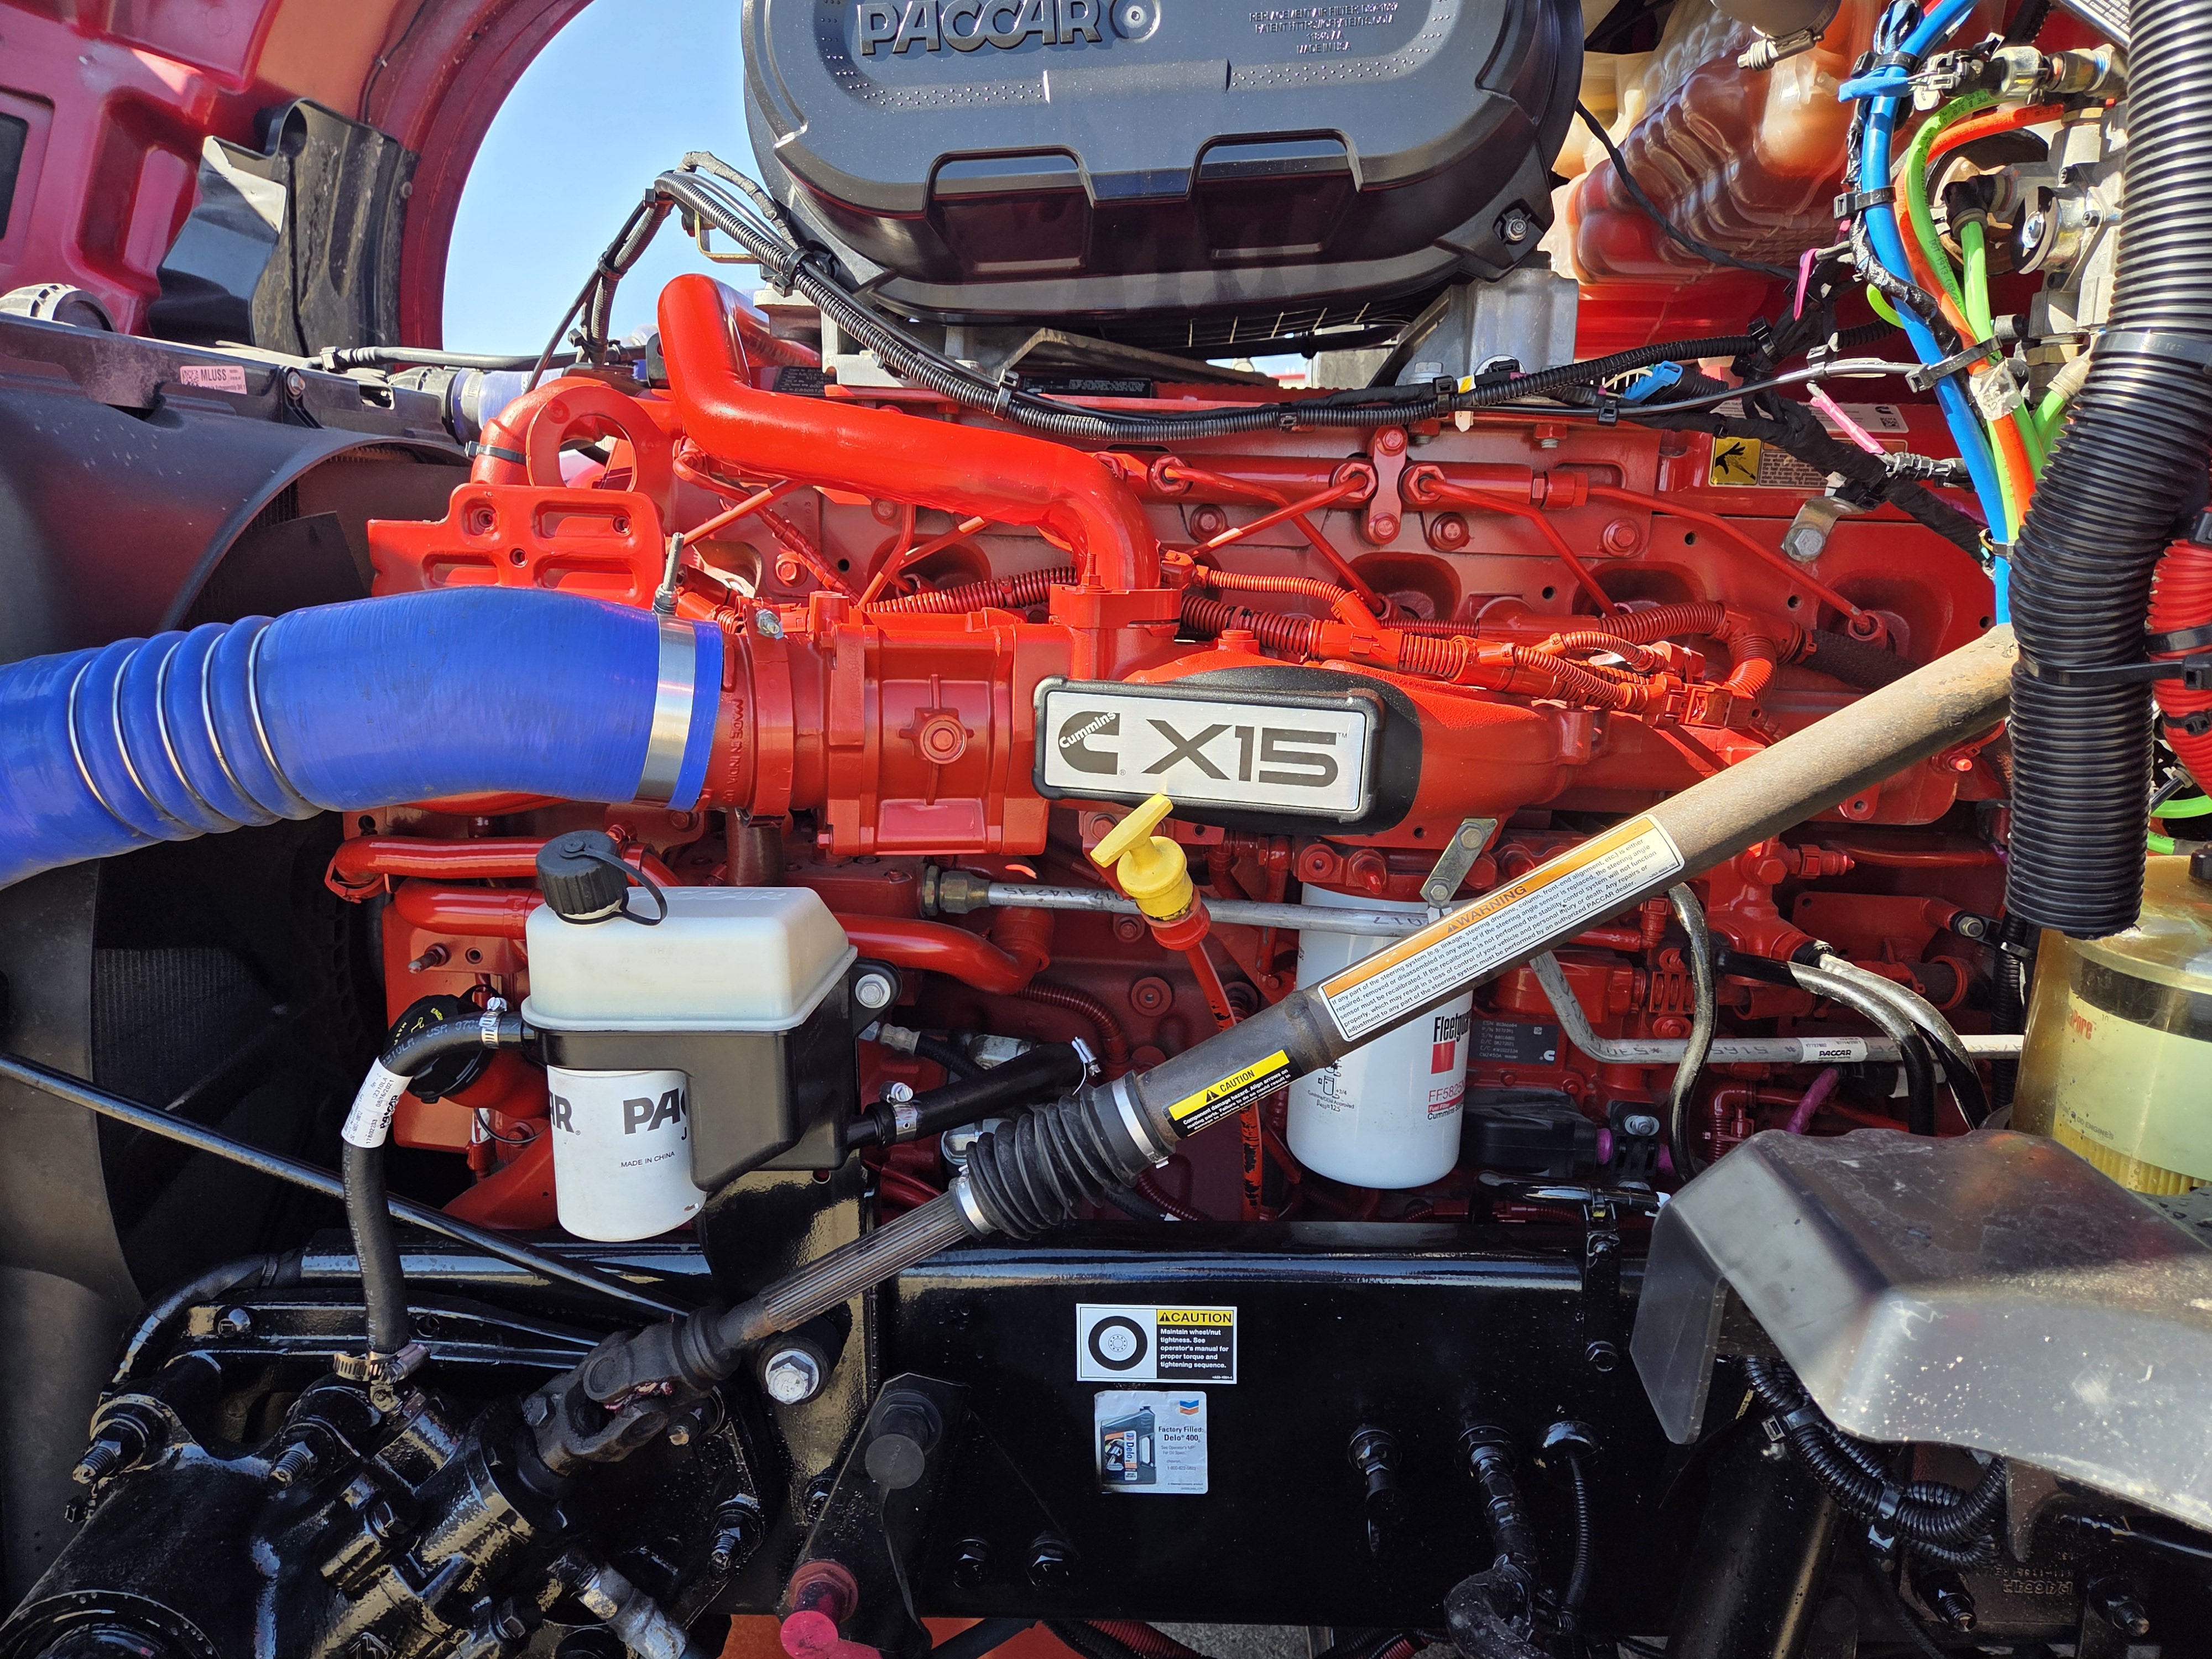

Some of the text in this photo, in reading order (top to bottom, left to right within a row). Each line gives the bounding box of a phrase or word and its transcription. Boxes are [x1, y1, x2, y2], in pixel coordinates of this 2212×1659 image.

[857, 0, 1103, 55] PACCAR
[1249, 8, 1312, 22] REPLACEMENT
[1312, 7, 1327, 17] AIR
[1297, 41, 1351, 54] MADE IN USA
[201, 369, 227, 381] MLUSS
[726, 699, 743, 785] MADE IN INDIA
[1059, 710, 1117, 749] Cummins
[1140, 718, 1338, 788] X15
[1336, 996, 1363, 1012] repaired,
[1363, 982, 1389, 998] removed
[1397, 956, 1438, 980] disassembled
[1445, 947, 1456, 956] any
[1457, 941, 1472, 949] way,
[1495, 914, 1521, 929] steering
[1521, 904, 1538, 915] angle
[1538, 893, 1559, 906] sensor
[1567, 874, 1595, 891] replaced,
[1606, 854, 1632, 870] steering
[1632, 845, 1650, 856] angle
[1349, 987, 1361, 997] part
[1380, 966, 1405, 980] steering
[1405, 954, 1427, 968] system
[1427, 948, 1441, 957] (e.g.
[1440, 935, 1465, 949] linkage,
[1465, 921, 1490, 936] steering
[1490, 907, 1518, 922] driveline,
[1518, 894, 1543, 907] column,
[1542, 877, 1572, 895] front-end
[1572, 861, 1604, 879] alignment,
[1604, 852, 1619, 862] etc.)
[1625, 839, 1642, 850] either
[1455, 884, 1527, 927] WARNING
[1340, 1006, 1359, 1019] sensor
[1360, 998, 1376, 1009] must
[1385, 974, 1422, 996] recalibrated.
[1439, 946, 1477, 968] recalibration
[1484, 936, 1495, 945] not
[1495, 919, 1526, 940] performed
[1538, 901, 1563, 916] stability
[1563, 888, 1584, 903] control
[1585, 877, 1608, 891] system
[1608, 870, 1619, 879] will
[1619, 864, 1631, 873] not
[1630, 851, 1656, 867] function
[1344, 1011, 1370, 1027] properly,
[1370, 1001, 1389, 1013] which
[1389, 994, 1401, 1003] may
[1402, 984, 1420, 996] result
[1432, 972, 1446, 981] loss
[1453, 955, 1475, 969] control
[1483, 945, 1496, 956] your
[1497, 933, 1519, 946] vehicle
[1520, 925, 1531, 935] and
[1532, 911, 1559, 930] personal
[1558, 902, 1576, 914] injury
[1585, 889, 1604, 900] death.
[1605, 881, 1617, 890] Any
[1618, 869, 1640, 883] repairs
[1348, 1014, 1380, 1032] adjustment
[1400, 997, 1412, 1006] part
[1431, 975, 1456, 989] steering
[1457, 963, 1478, 977] system
[1479, 954, 1495, 965] must
[1504, 932, 1536, 953] performed
[1553, 905, 1586, 926] authorized
[1586, 891, 1614, 908] PACCAR
[1615, 881, 1636, 893] dealer.
[1183, 1108, 1211, 1124] Component
[1211, 1098, 1230, 1110] damage
[1230, 1088, 1250, 1100] hazard.
[1250, 1082, 1263, 1091] Align
[1263, 1073, 1281, 1083] arrows
[1187, 1118, 1205, 1129] mating
[1204, 1112, 1219, 1120] parts.
[1218, 1102, 1236, 1112] Failure
[1256, 1084, 1270, 1093] could
[1270, 1076, 1285, 1086] result
[1219, 1070, 1255, 1092] CAUTION
[1194, 1119, 1213, 1130] damage
[1219, 1105, 1239, 1117] steering
[1240, 1095, 1257, 1106] system
[1258, 1081, 1290, 1097] components.
[1428, 1108, 1455, 1120] Cummins
[2085, 1121, 2114, 1140] ENGINES
[620, 1159, 643, 1168] MADE
[654, 1151, 675, 1162] CHINA
[1171, 1312, 1232, 1323] CAUTION
[1126, 1442, 1134, 1459] Delo
